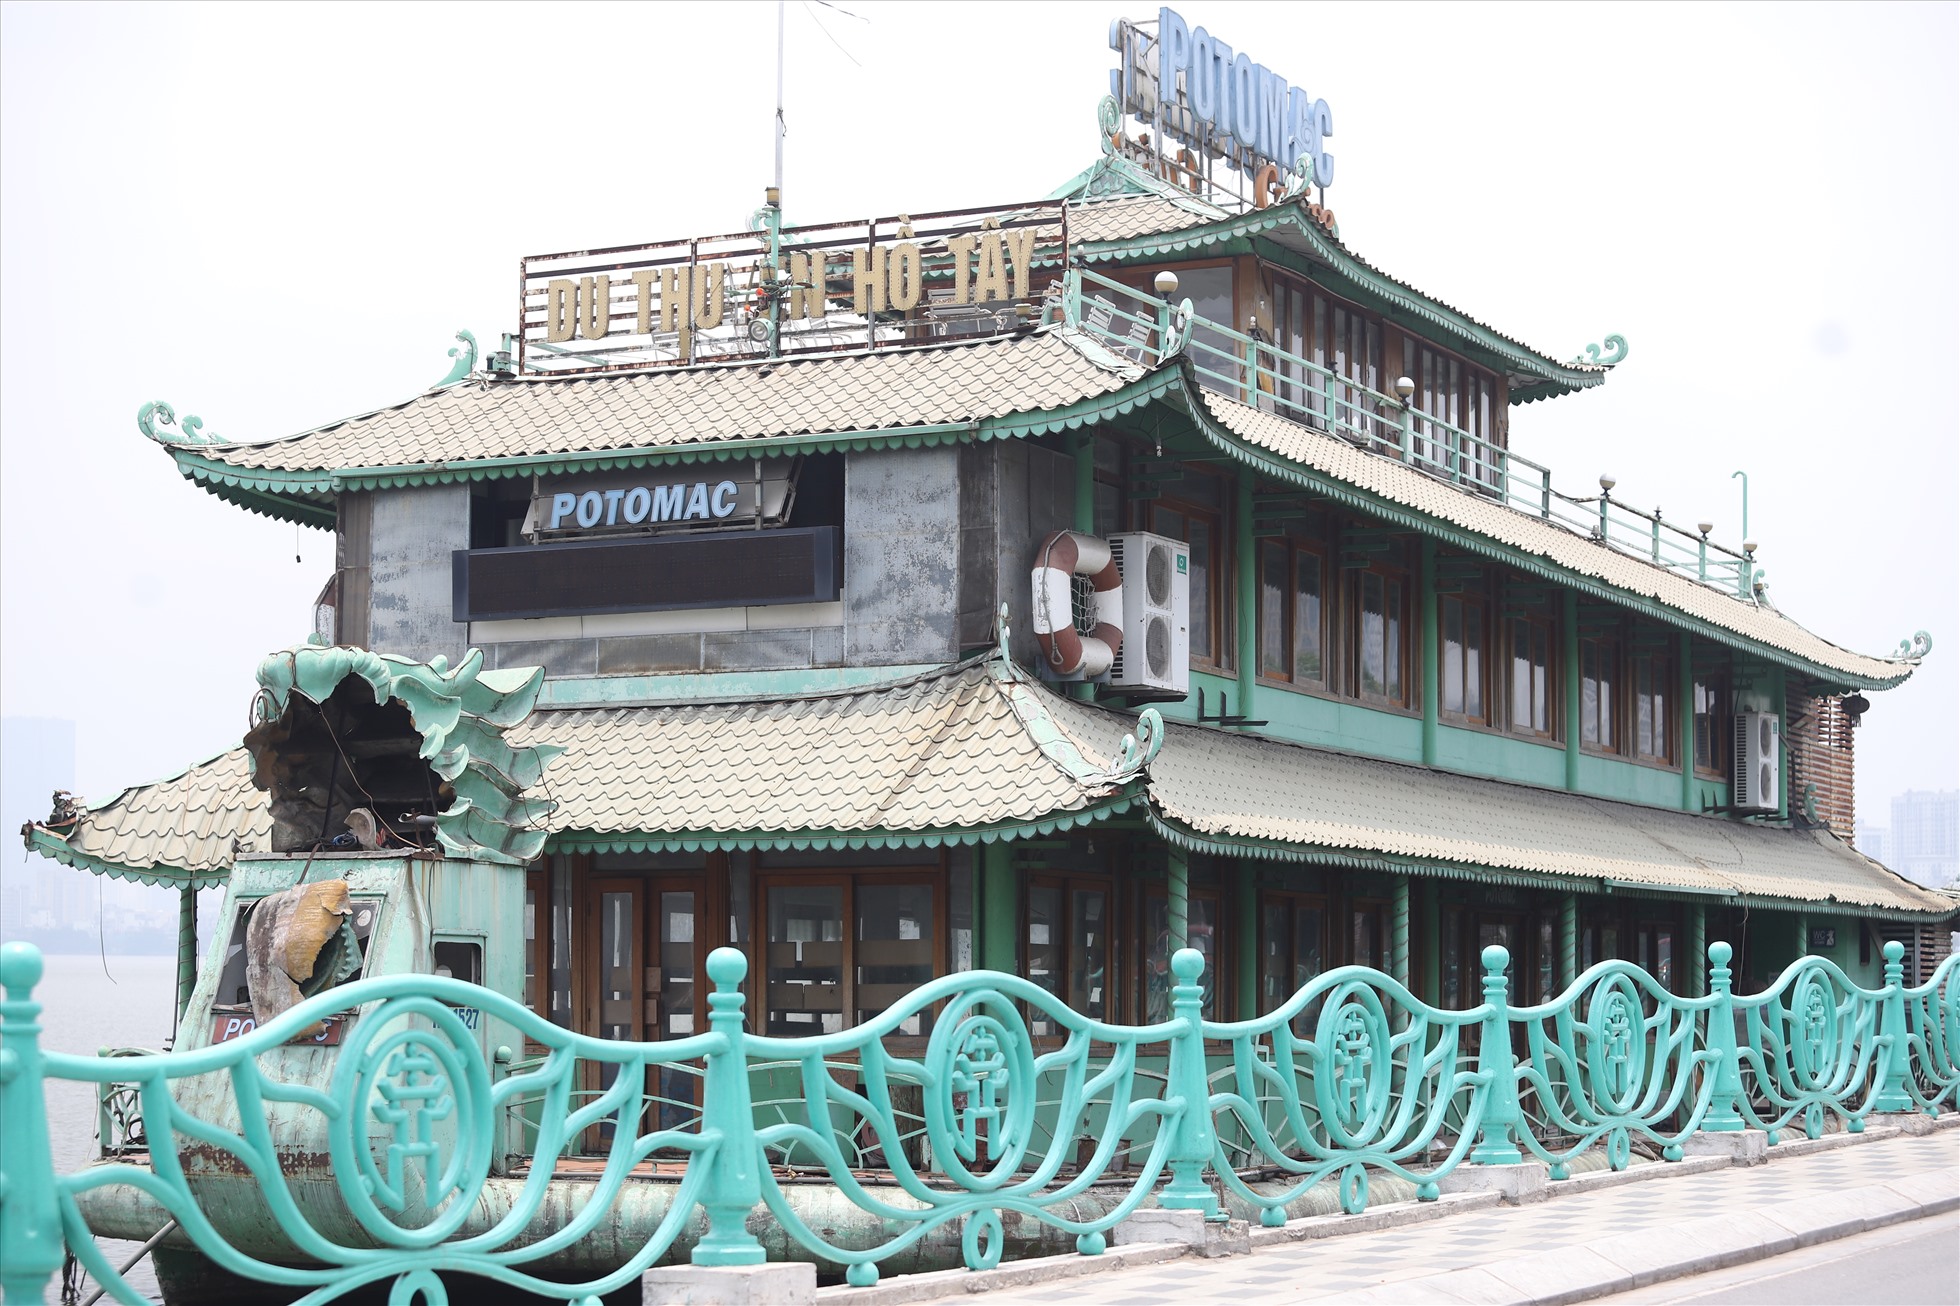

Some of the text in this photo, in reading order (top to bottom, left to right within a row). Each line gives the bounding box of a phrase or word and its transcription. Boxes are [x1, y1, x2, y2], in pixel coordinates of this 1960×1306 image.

[1158, 6, 1335, 189] POTOMAC
[547, 213, 1038, 343] DU THUN HỒ TÂY
[550, 480, 738, 529] POTOMAC
[1485, 887, 1517, 904] POTOC
[1813, 930, 1826, 939] WC
